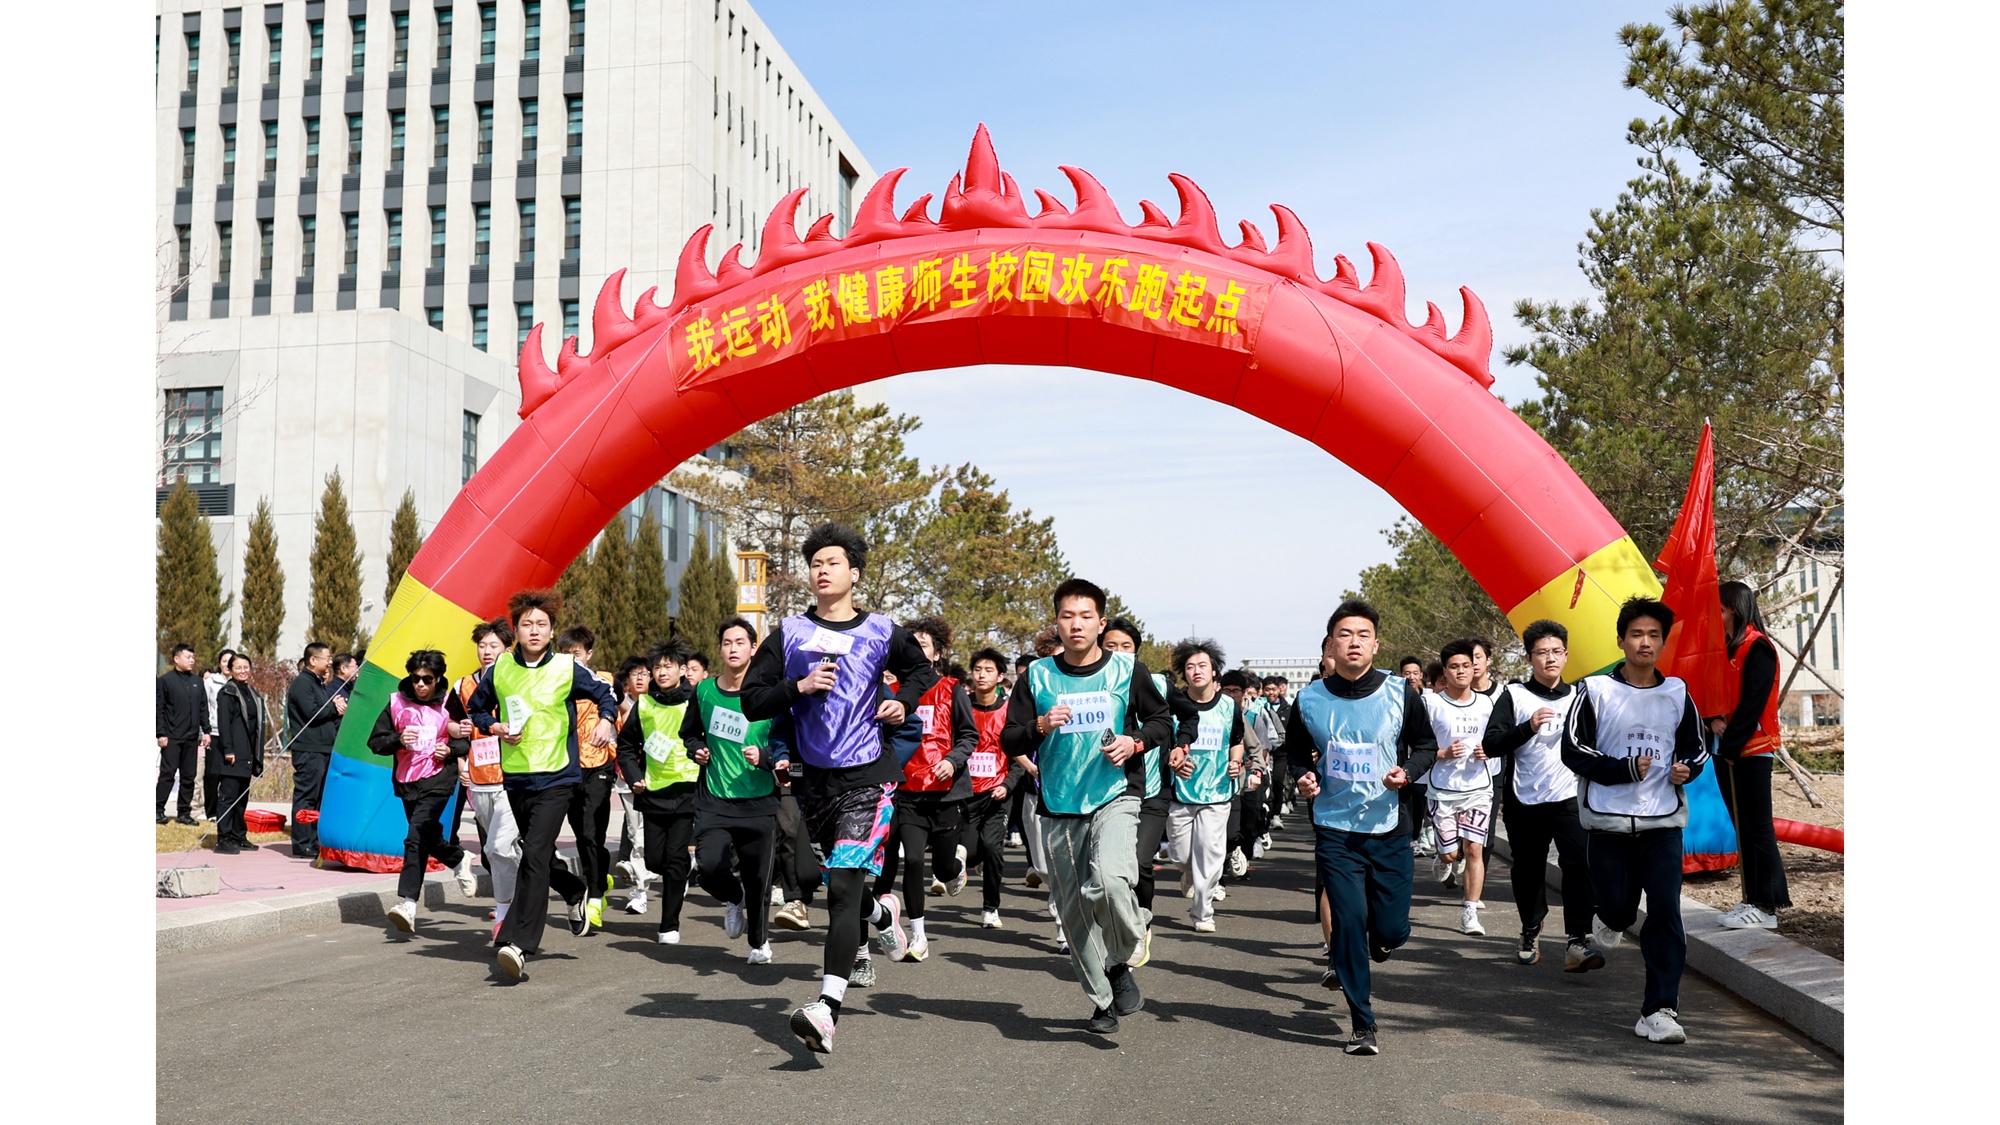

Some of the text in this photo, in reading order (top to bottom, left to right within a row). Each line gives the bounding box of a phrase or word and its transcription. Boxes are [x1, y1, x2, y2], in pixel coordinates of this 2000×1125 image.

[685, 294, 792, 372] 我运动
[1060, 695, 1107, 706] 医学技术学院
[1066, 710, 1105, 726] 3109
[712, 721, 741, 737] 5109
[1456, 725, 1479, 734] 1120
[1628, 732, 1661, 743] 护理学院
[1331, 745, 1373, 756] 口腔医学院
[1626, 746, 1661, 761] 1105
[969, 764, 993, 773] 6115
[1332, 758, 1371, 775] 2106
